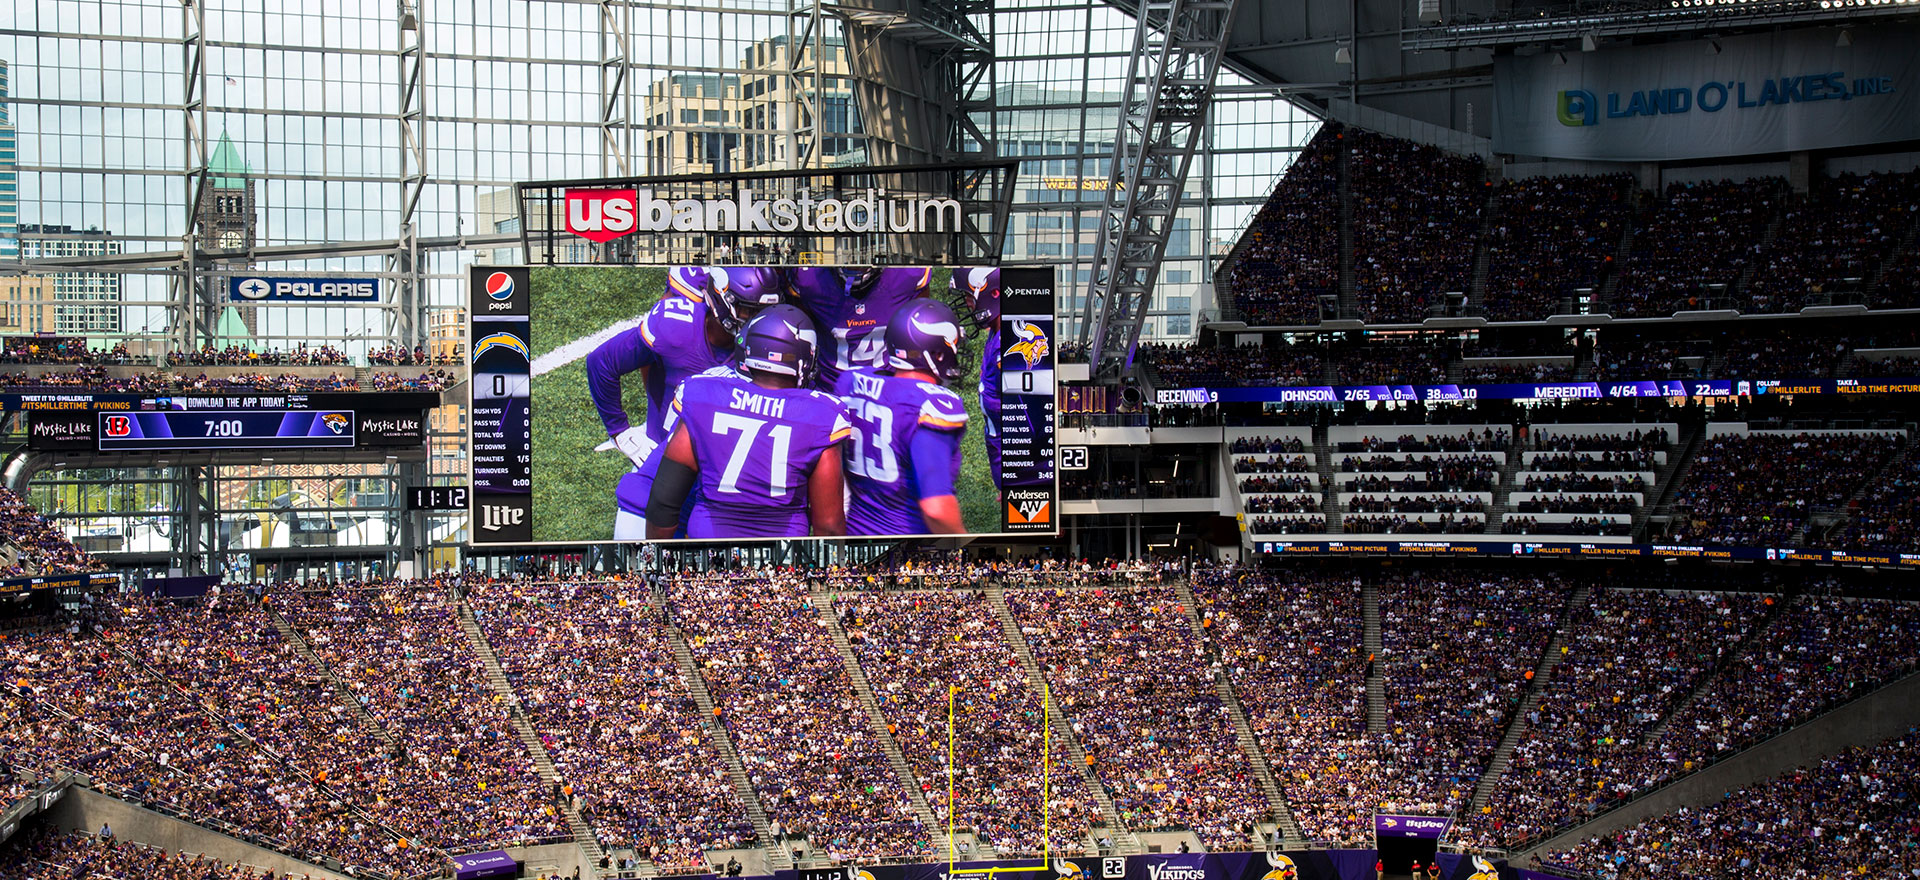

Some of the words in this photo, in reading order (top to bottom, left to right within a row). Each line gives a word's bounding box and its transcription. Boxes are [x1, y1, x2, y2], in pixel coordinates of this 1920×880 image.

[1607, 87, 1692, 119] LAND
[275, 282, 373, 297] POLARIS
[1015, 288, 1050, 296] PENTAIR
[488, 302, 512, 311] pepsi
[831, 325, 887, 370] 14
[1157, 390, 1205, 403] RECEIVING
[1210, 391, 1218, 402] 9
[1281, 390, 1333, 402] JOHNSON
[1344, 390, 1370, 401] 2/65
[1394, 389, 1401, 400] 0
[1427, 389, 1440, 399] 38
[1462, 388, 1477, 399] 10
[1535, 386, 1597, 398] MEREDITH
[1609, 386, 1637, 397] 4/64
[1662, 385, 1670, 395] 1
[1695, 384, 1711, 395] 22
[1767, 386, 1821, 394] @MILLERLITE
[188, 398, 224, 408] DOWNLOAD
[226, 398, 239, 408] THE
[242, 398, 257, 408] APP
[260, 397, 284, 408] TODAY!
[730, 387, 786, 418] SMITH
[204, 420, 242, 436] 7:00
[712, 411, 792, 497] 71
[1063, 450, 1085, 468] 22
[418, 488, 465, 507] 11:12
[1008, 490, 1050, 500] Andersen
[482, 505, 524, 531] Lite
[1106, 860, 1122, 874] 22
